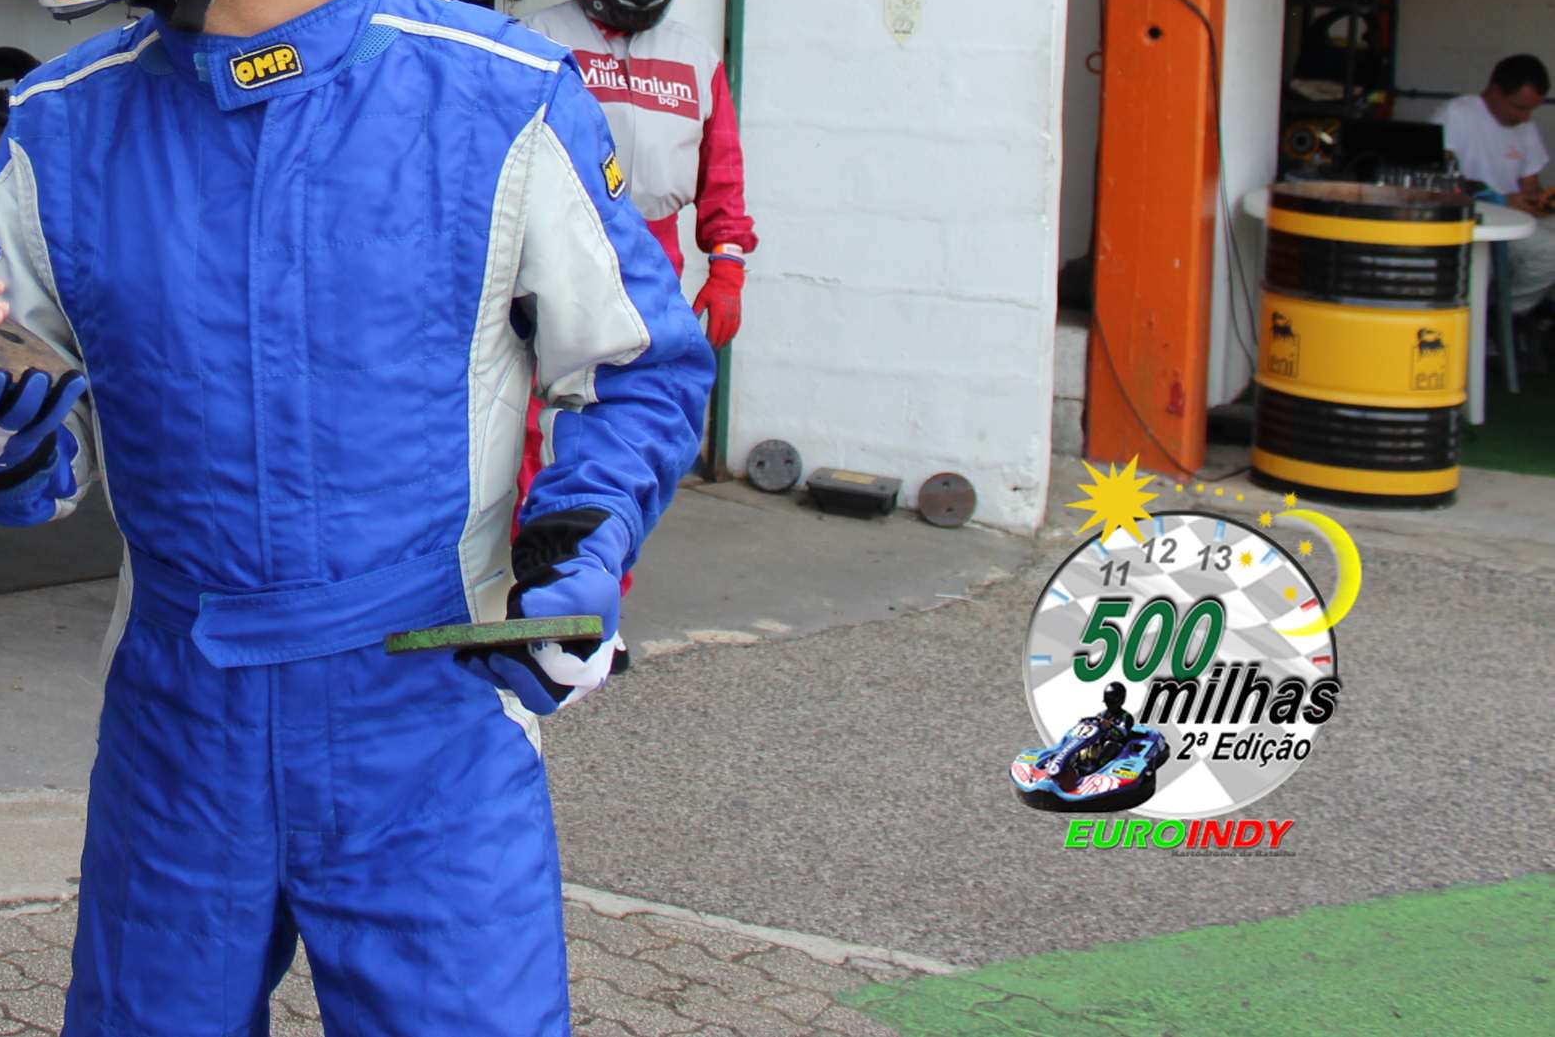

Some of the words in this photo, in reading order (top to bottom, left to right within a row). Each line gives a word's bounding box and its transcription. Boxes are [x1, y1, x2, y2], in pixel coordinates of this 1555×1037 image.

[235, 48, 294, 83] OMP
[589, 58, 619, 71] club
[657, 94, 680, 109] bcp
[1416, 370, 1445, 389] eni
